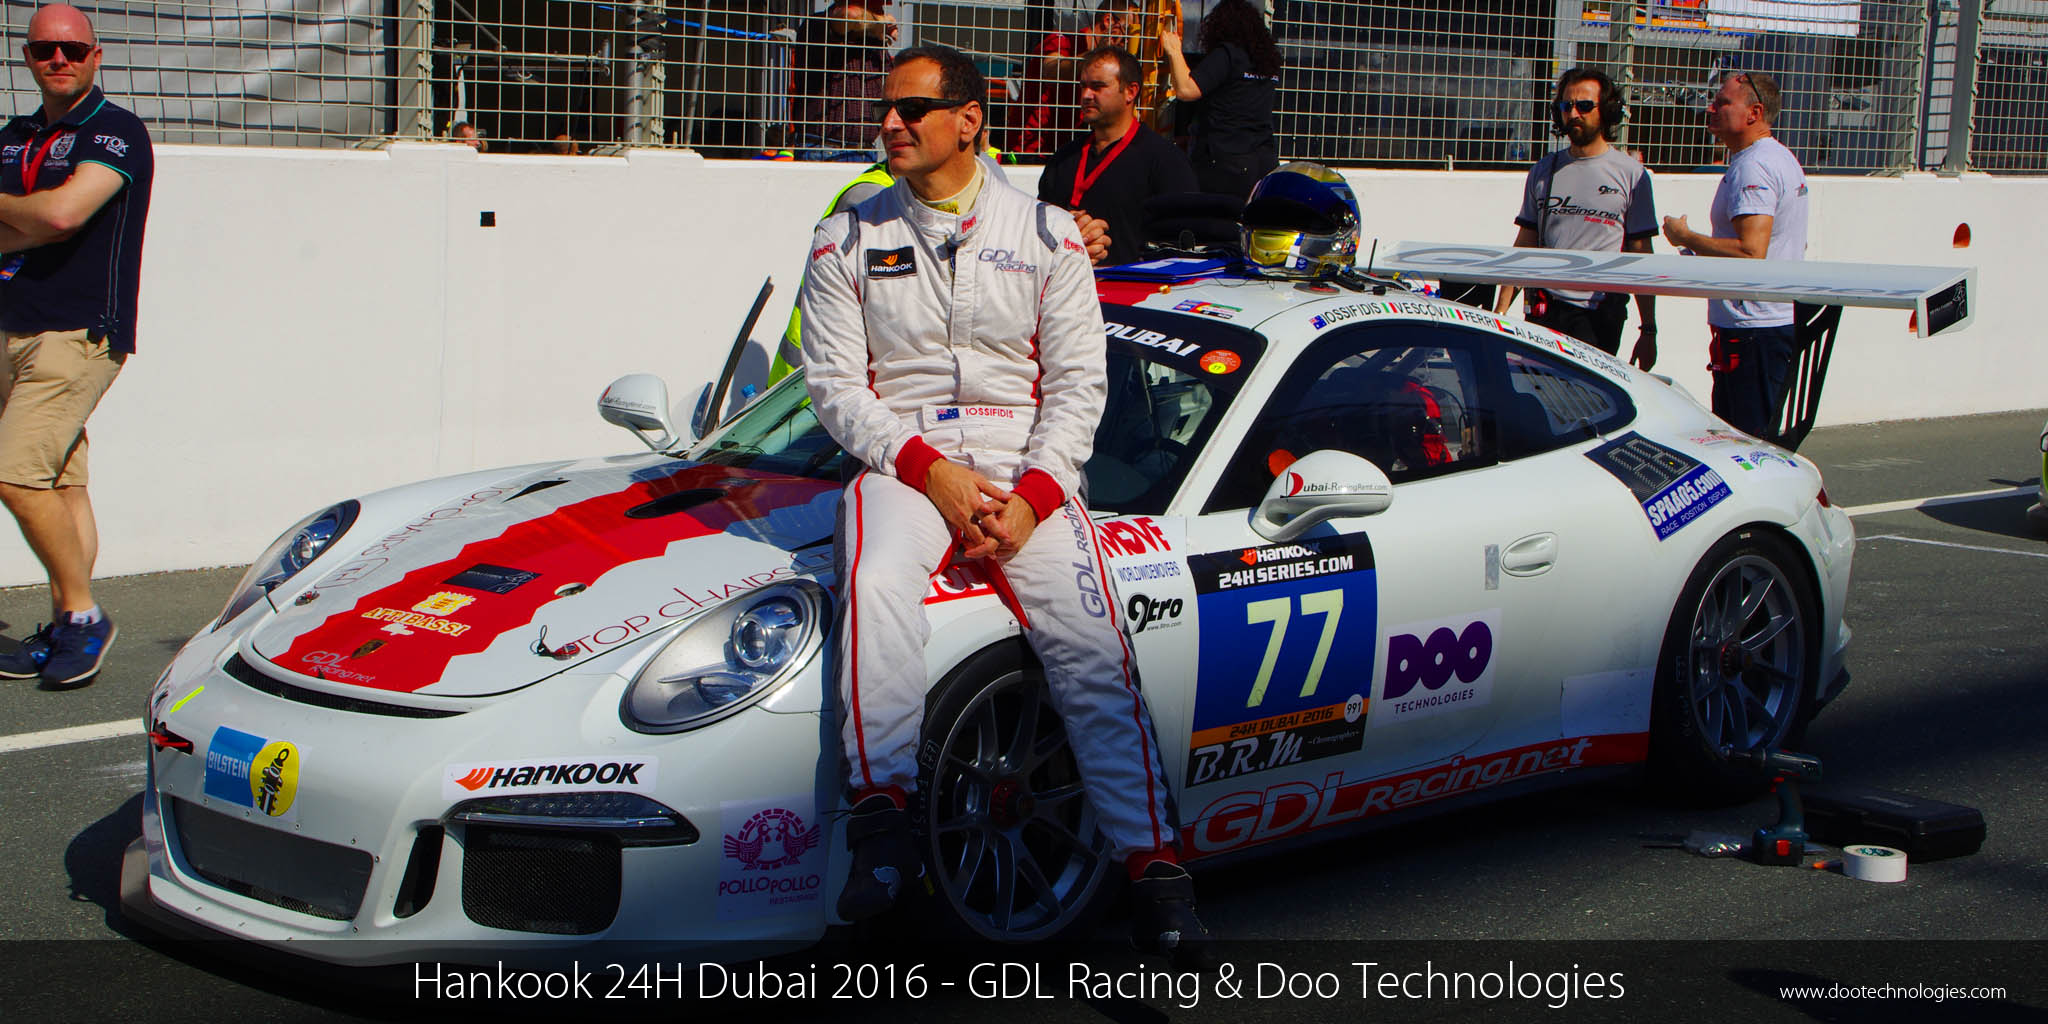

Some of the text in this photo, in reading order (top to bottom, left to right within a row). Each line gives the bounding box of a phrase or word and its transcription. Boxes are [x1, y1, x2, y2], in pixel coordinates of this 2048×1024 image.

[978, 248, 1021, 263] GDL
[994, 260, 1038, 274] Racing
[1322, 302, 1382, 324] IOSSIFIDIS
[1395, 302, 1449, 318] VESCOVI
[1462, 310, 1497, 329] FERRI
[965, 407, 1014, 419] IOSSIFIDIS
[1647, 468, 1725, 527] SPAA05.com
[1660, 487, 1728, 536] RACE POSITION DISPLAY
[1219, 555, 1354, 589] 24H SERIES.COM
[361, 607, 472, 637] ATTIBASSI
[576, 566, 799, 654] TOP CHAIRS
[301, 650, 350, 668] GDL
[1246, 588, 1344, 708] 77
[1382, 620, 1493, 701] DOO
[1347, 702, 1362, 714] 991
[1394, 688, 1475, 715] TECHNOLOGIES
[1230, 707, 1335, 739] 24H DUBAI 2016
[207, 751, 250, 780] BILSTEIN
